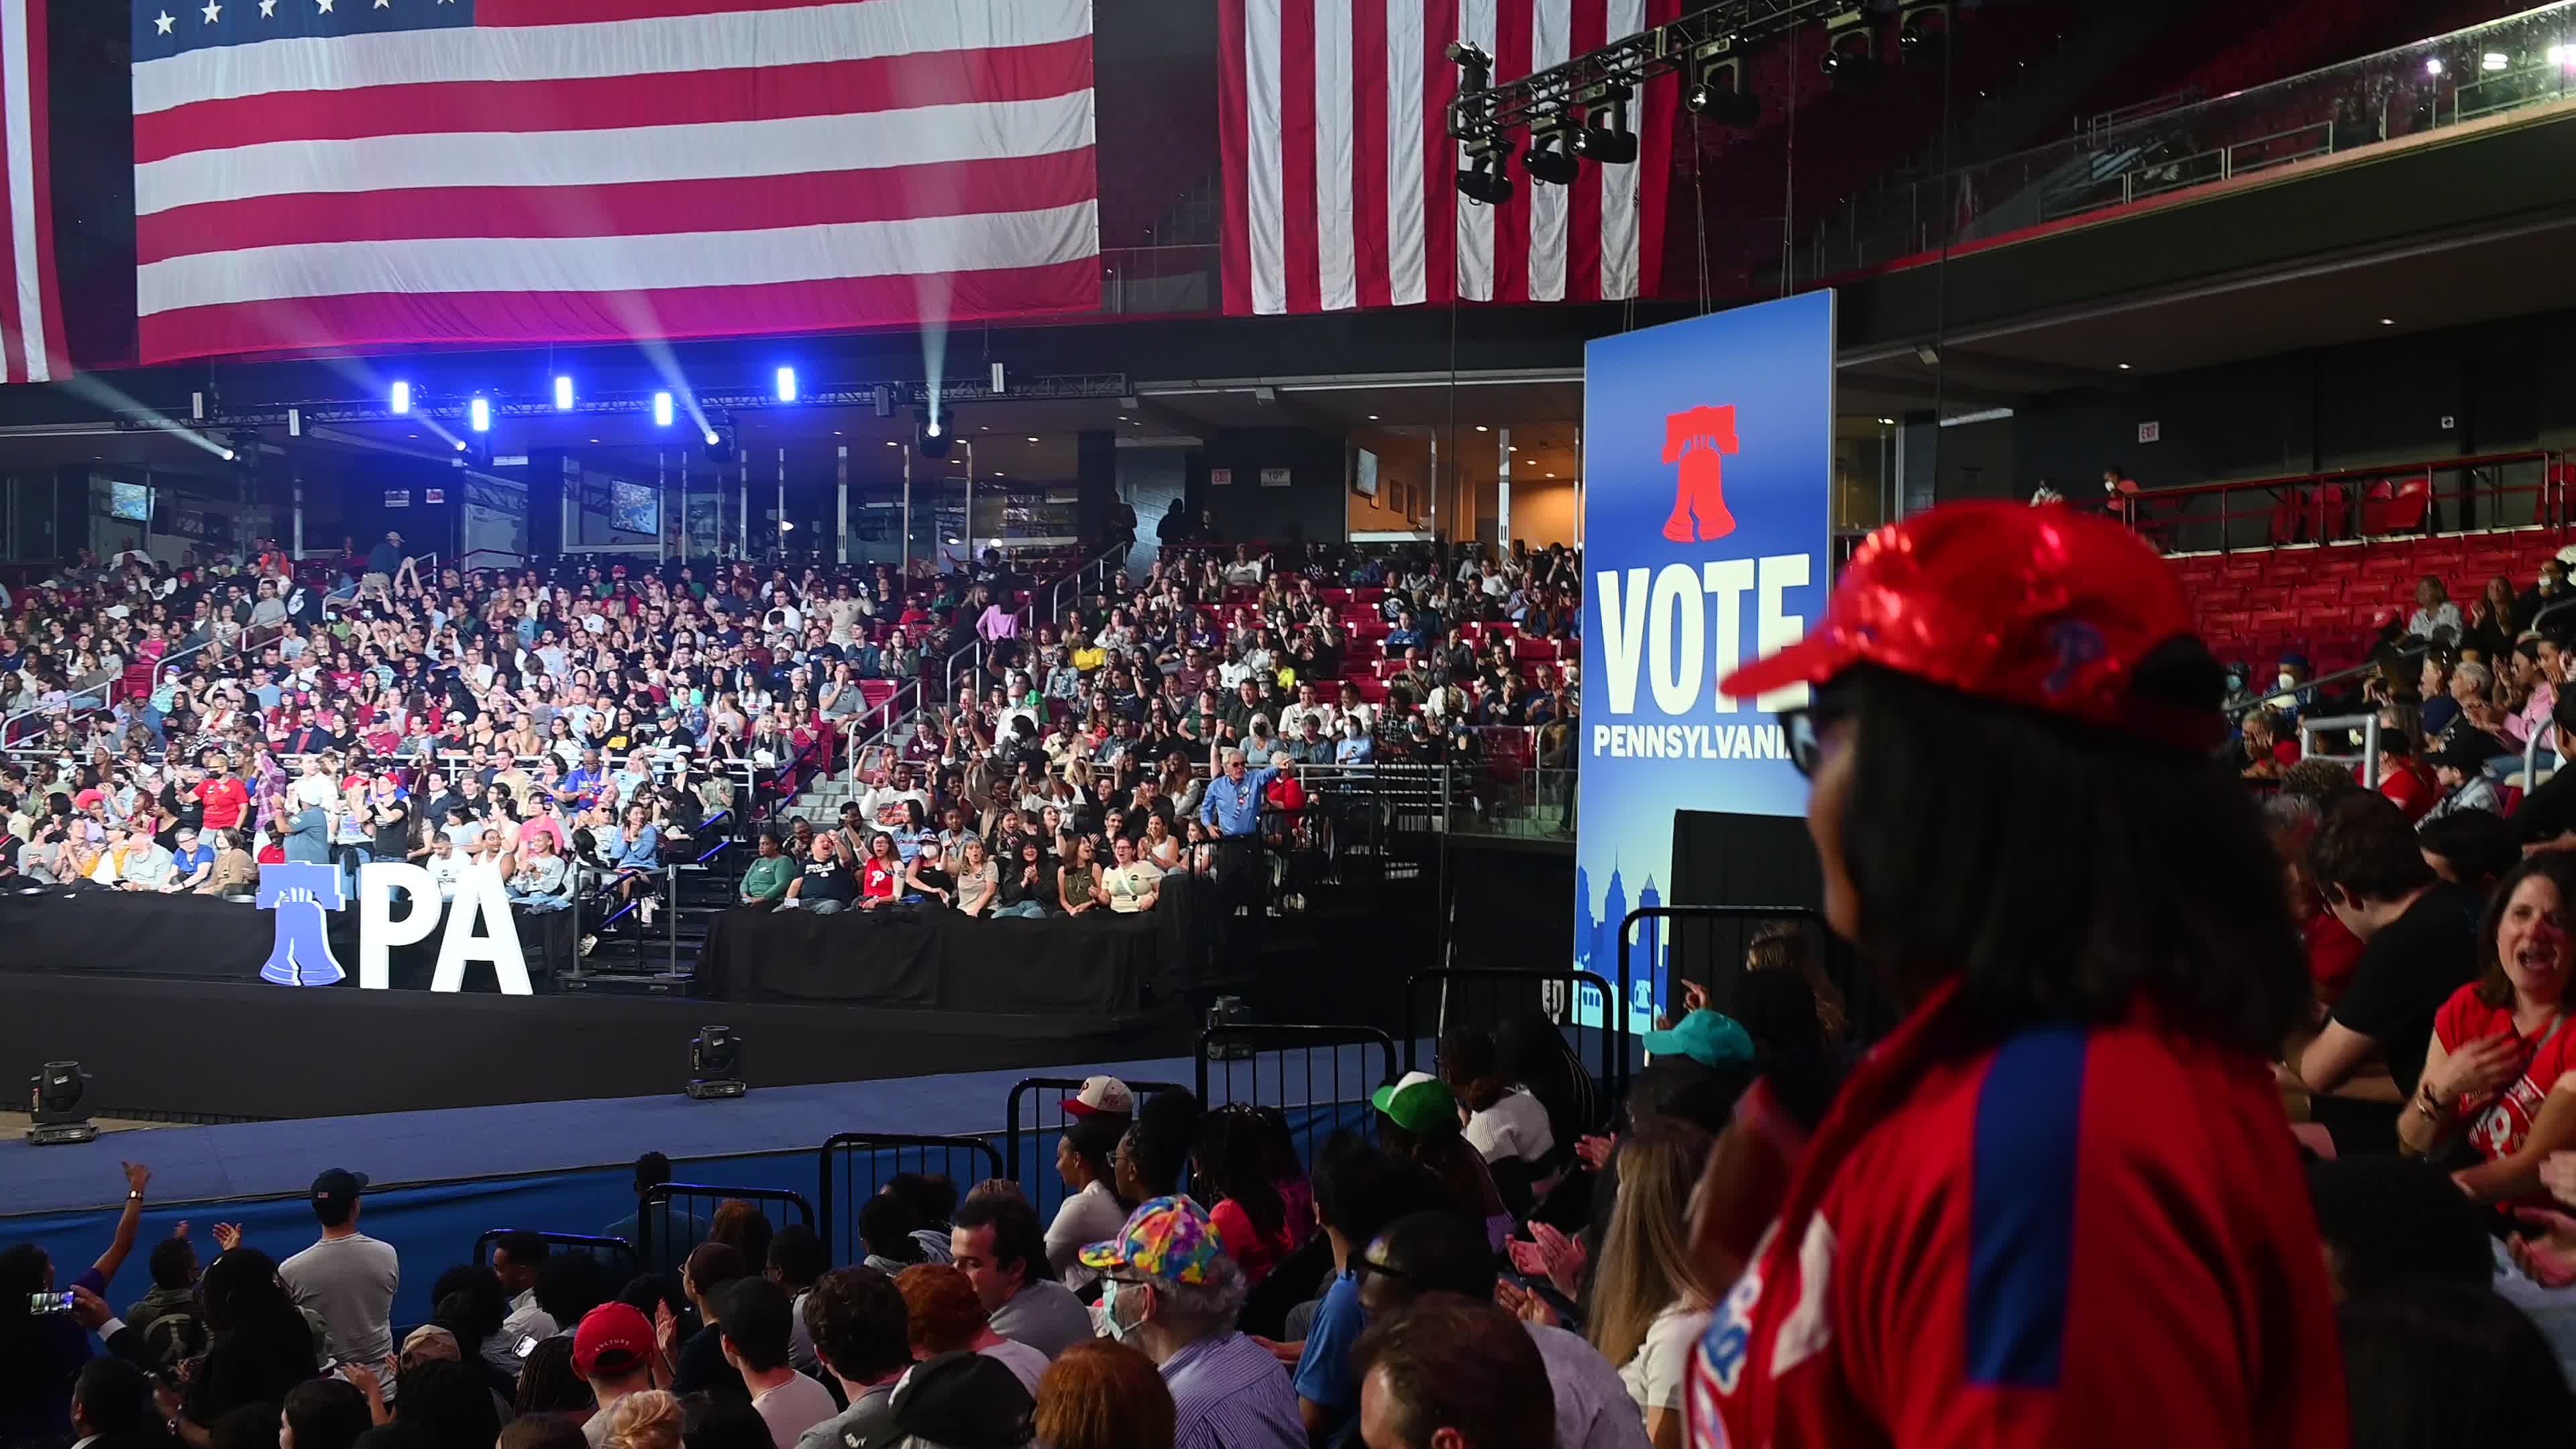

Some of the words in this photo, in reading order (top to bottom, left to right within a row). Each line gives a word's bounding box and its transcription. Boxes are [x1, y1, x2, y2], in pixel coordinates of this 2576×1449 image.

[1597, 553, 1810, 716] VOTE
[1593, 724, 1792, 760] PENNSYLVANI
[360, 862, 533, 995] PA
[595, 1339, 630, 1352] CULTURE
